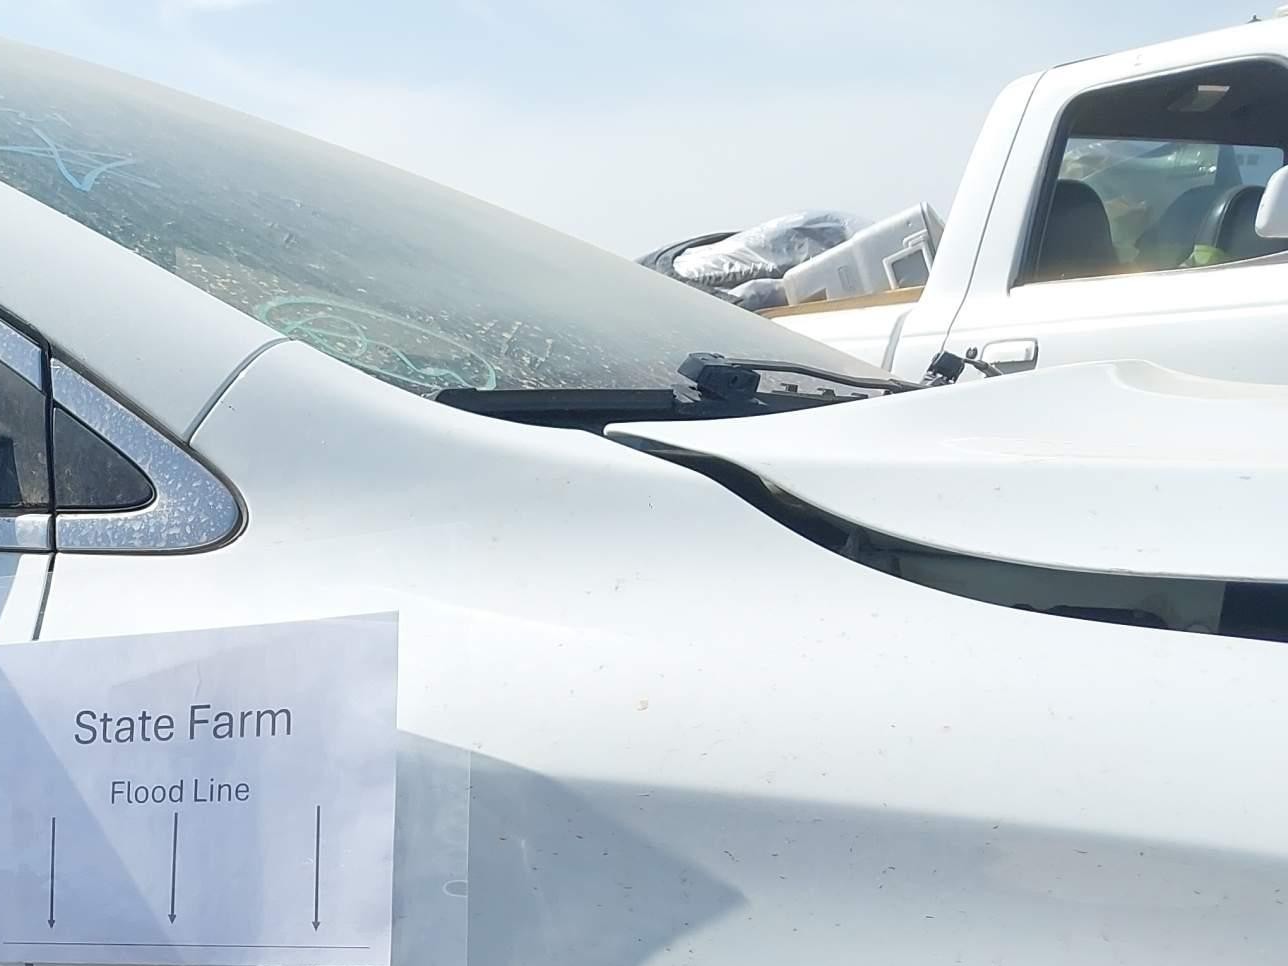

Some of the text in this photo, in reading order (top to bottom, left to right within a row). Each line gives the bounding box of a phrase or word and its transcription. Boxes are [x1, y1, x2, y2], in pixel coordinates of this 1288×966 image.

[73, 704, 292, 746] State Farm
[111, 777, 251, 805] Flood Line
